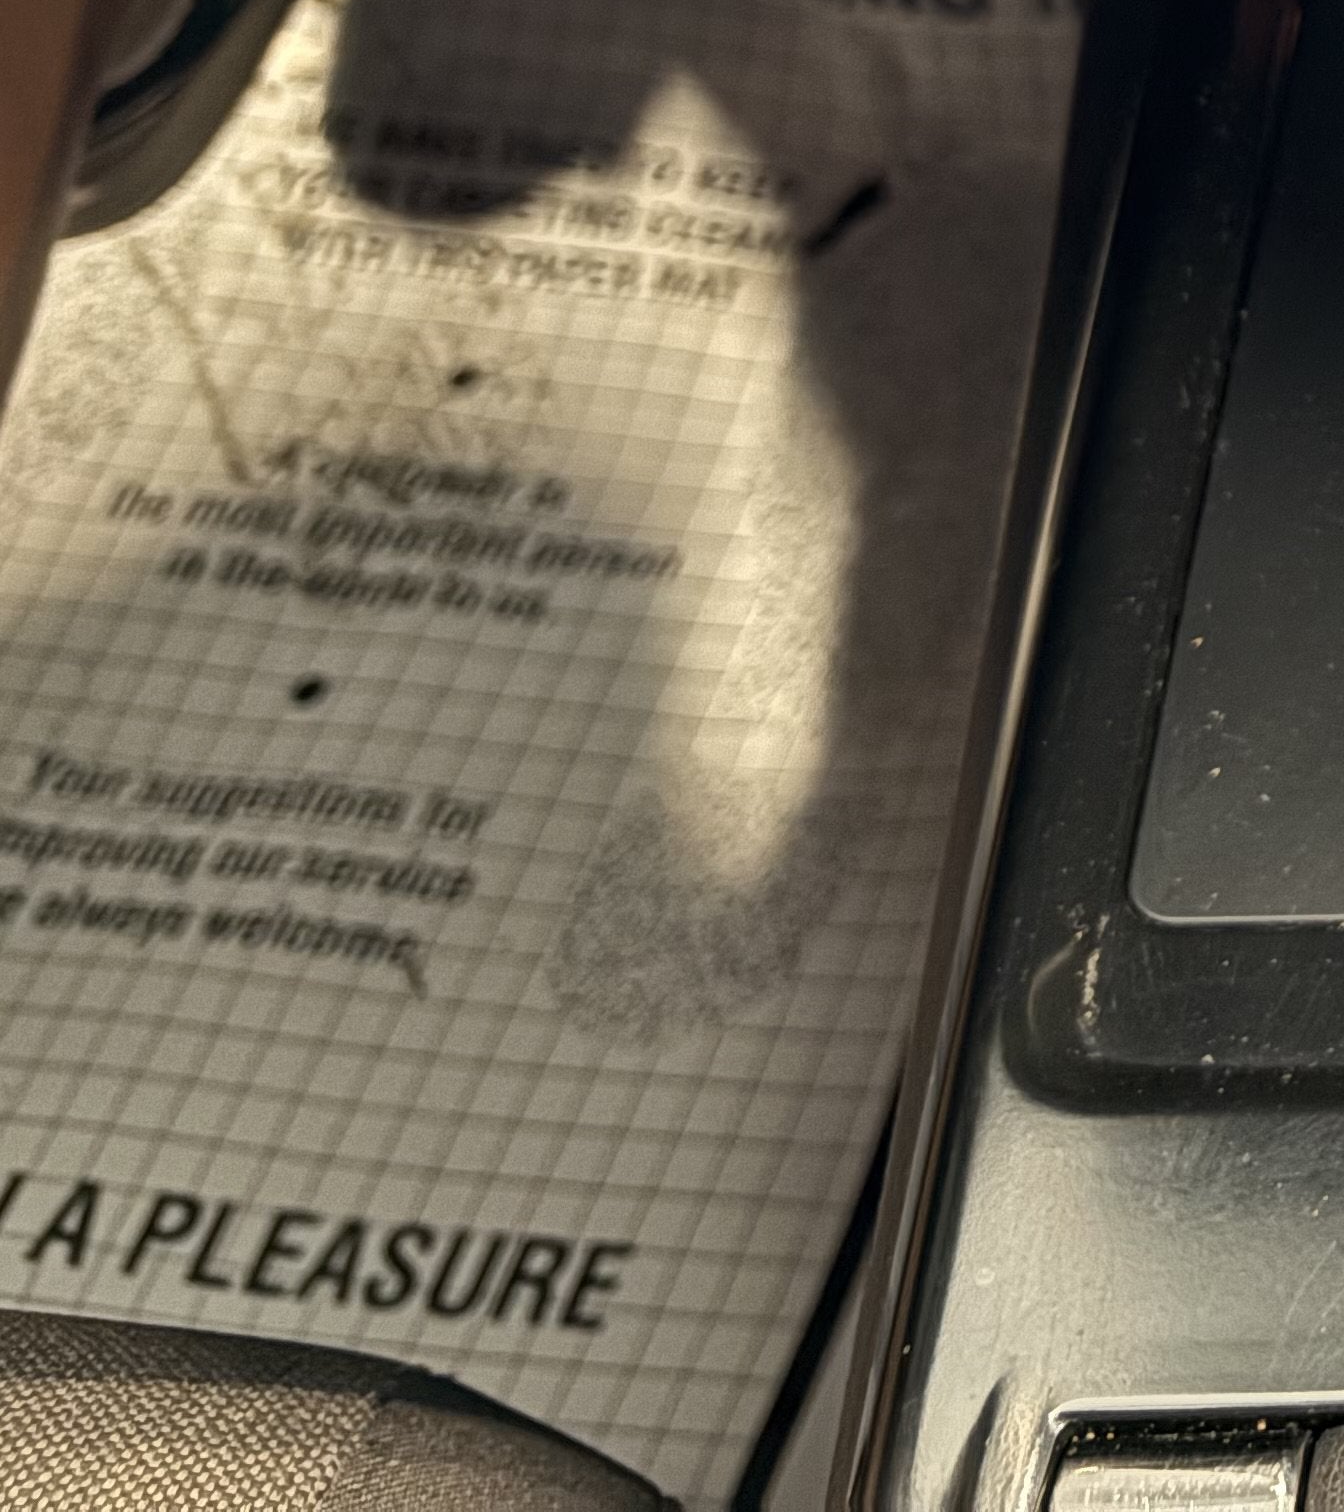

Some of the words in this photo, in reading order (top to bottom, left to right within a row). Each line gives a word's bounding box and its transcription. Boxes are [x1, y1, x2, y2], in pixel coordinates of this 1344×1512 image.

[105, 482, 173, 524] the
[181, 491, 299, 538] most
[302, 500, 526, 560] important
[32, 750, 133, 801] Your
[135, 768, 407, 826] suggestions
[208, 836, 292, 880] our
[292, 844, 476, 906] service
[30, 884, 196, 950] always
[23, 1176, 103, 1270] A
[118, 1186, 637, 1334] PLEASURE
